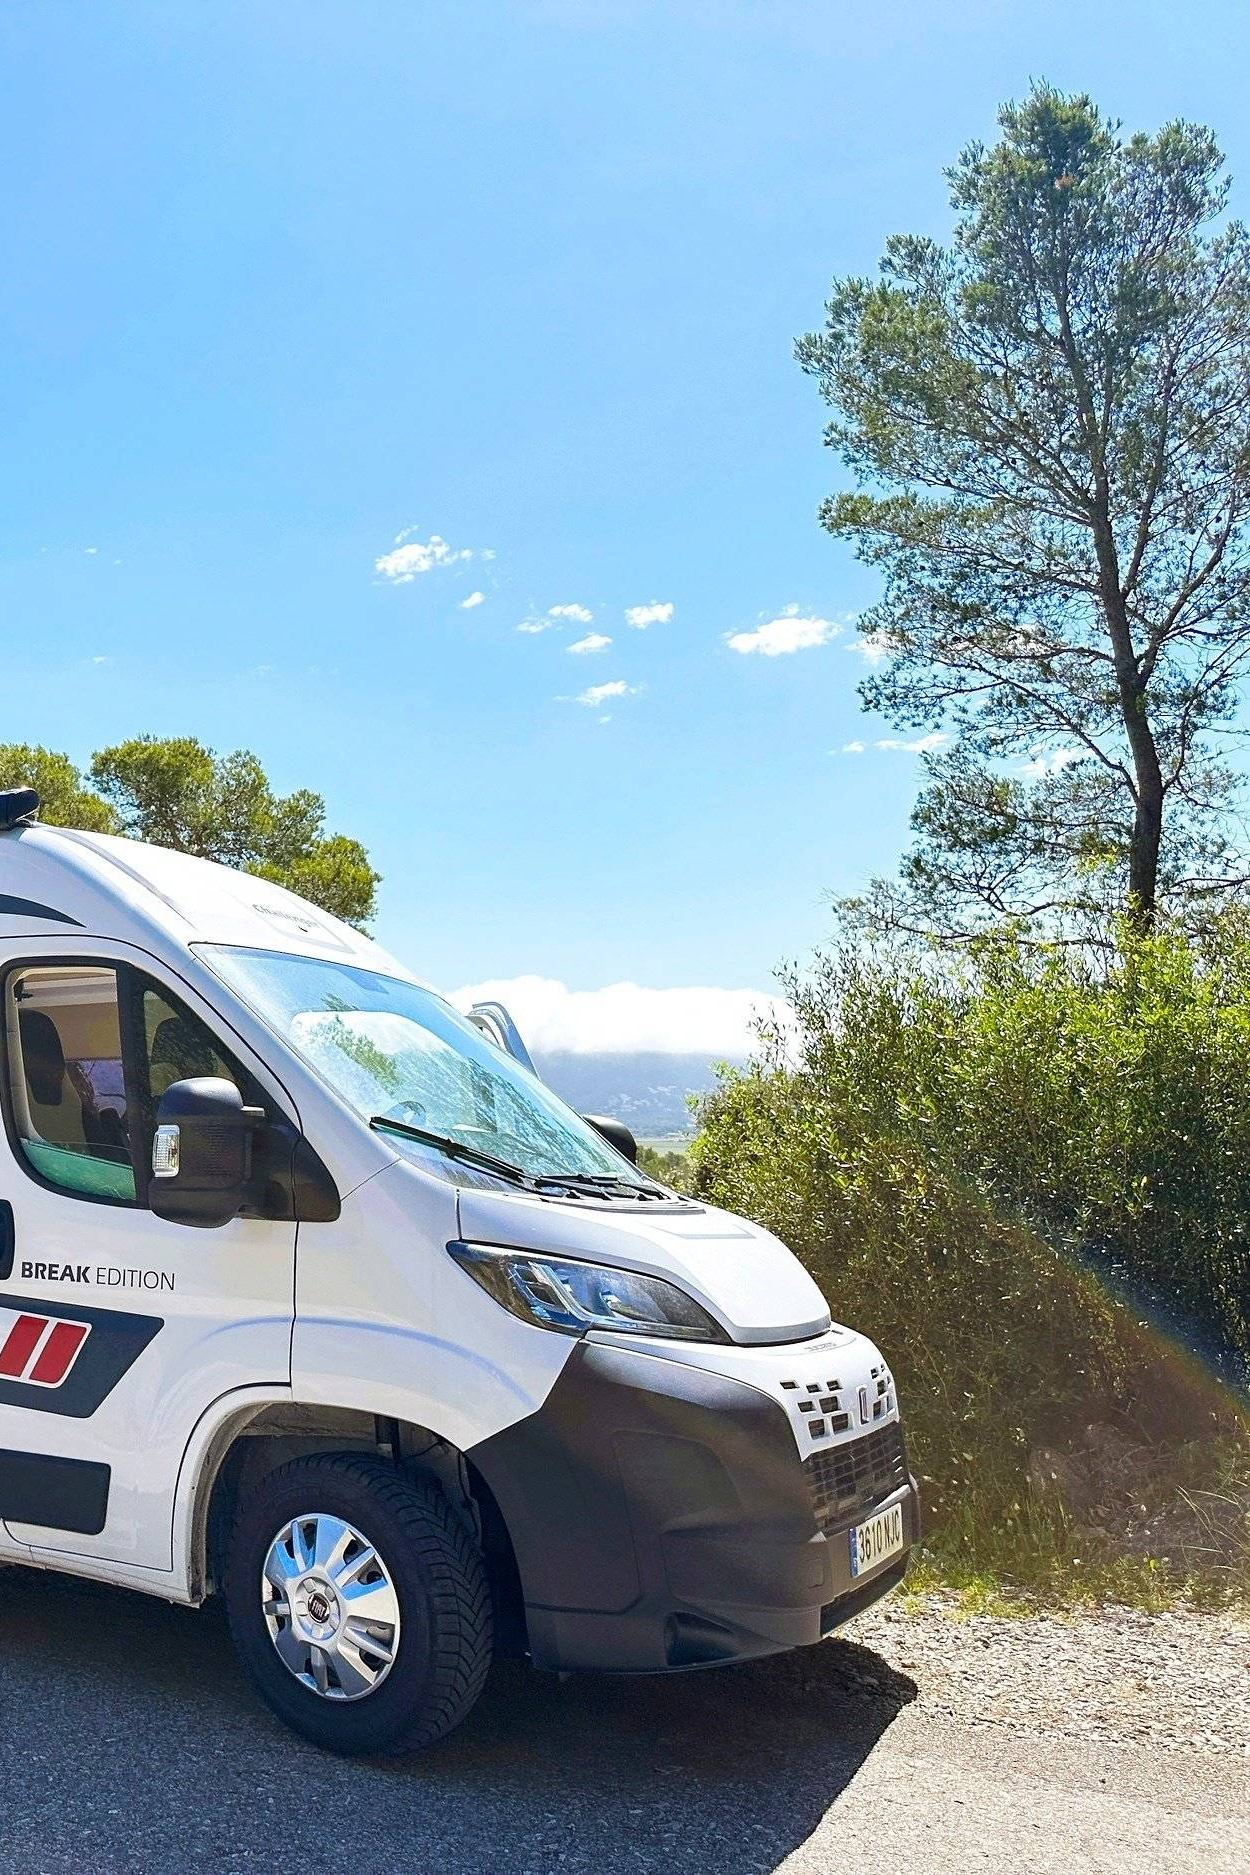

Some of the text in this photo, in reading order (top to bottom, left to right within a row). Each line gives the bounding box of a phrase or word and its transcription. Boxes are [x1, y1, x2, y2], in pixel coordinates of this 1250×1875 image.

[21, 1261, 175, 1290] BREAK EDITION
[858, 1510, 900, 1563] 3610 NJC
